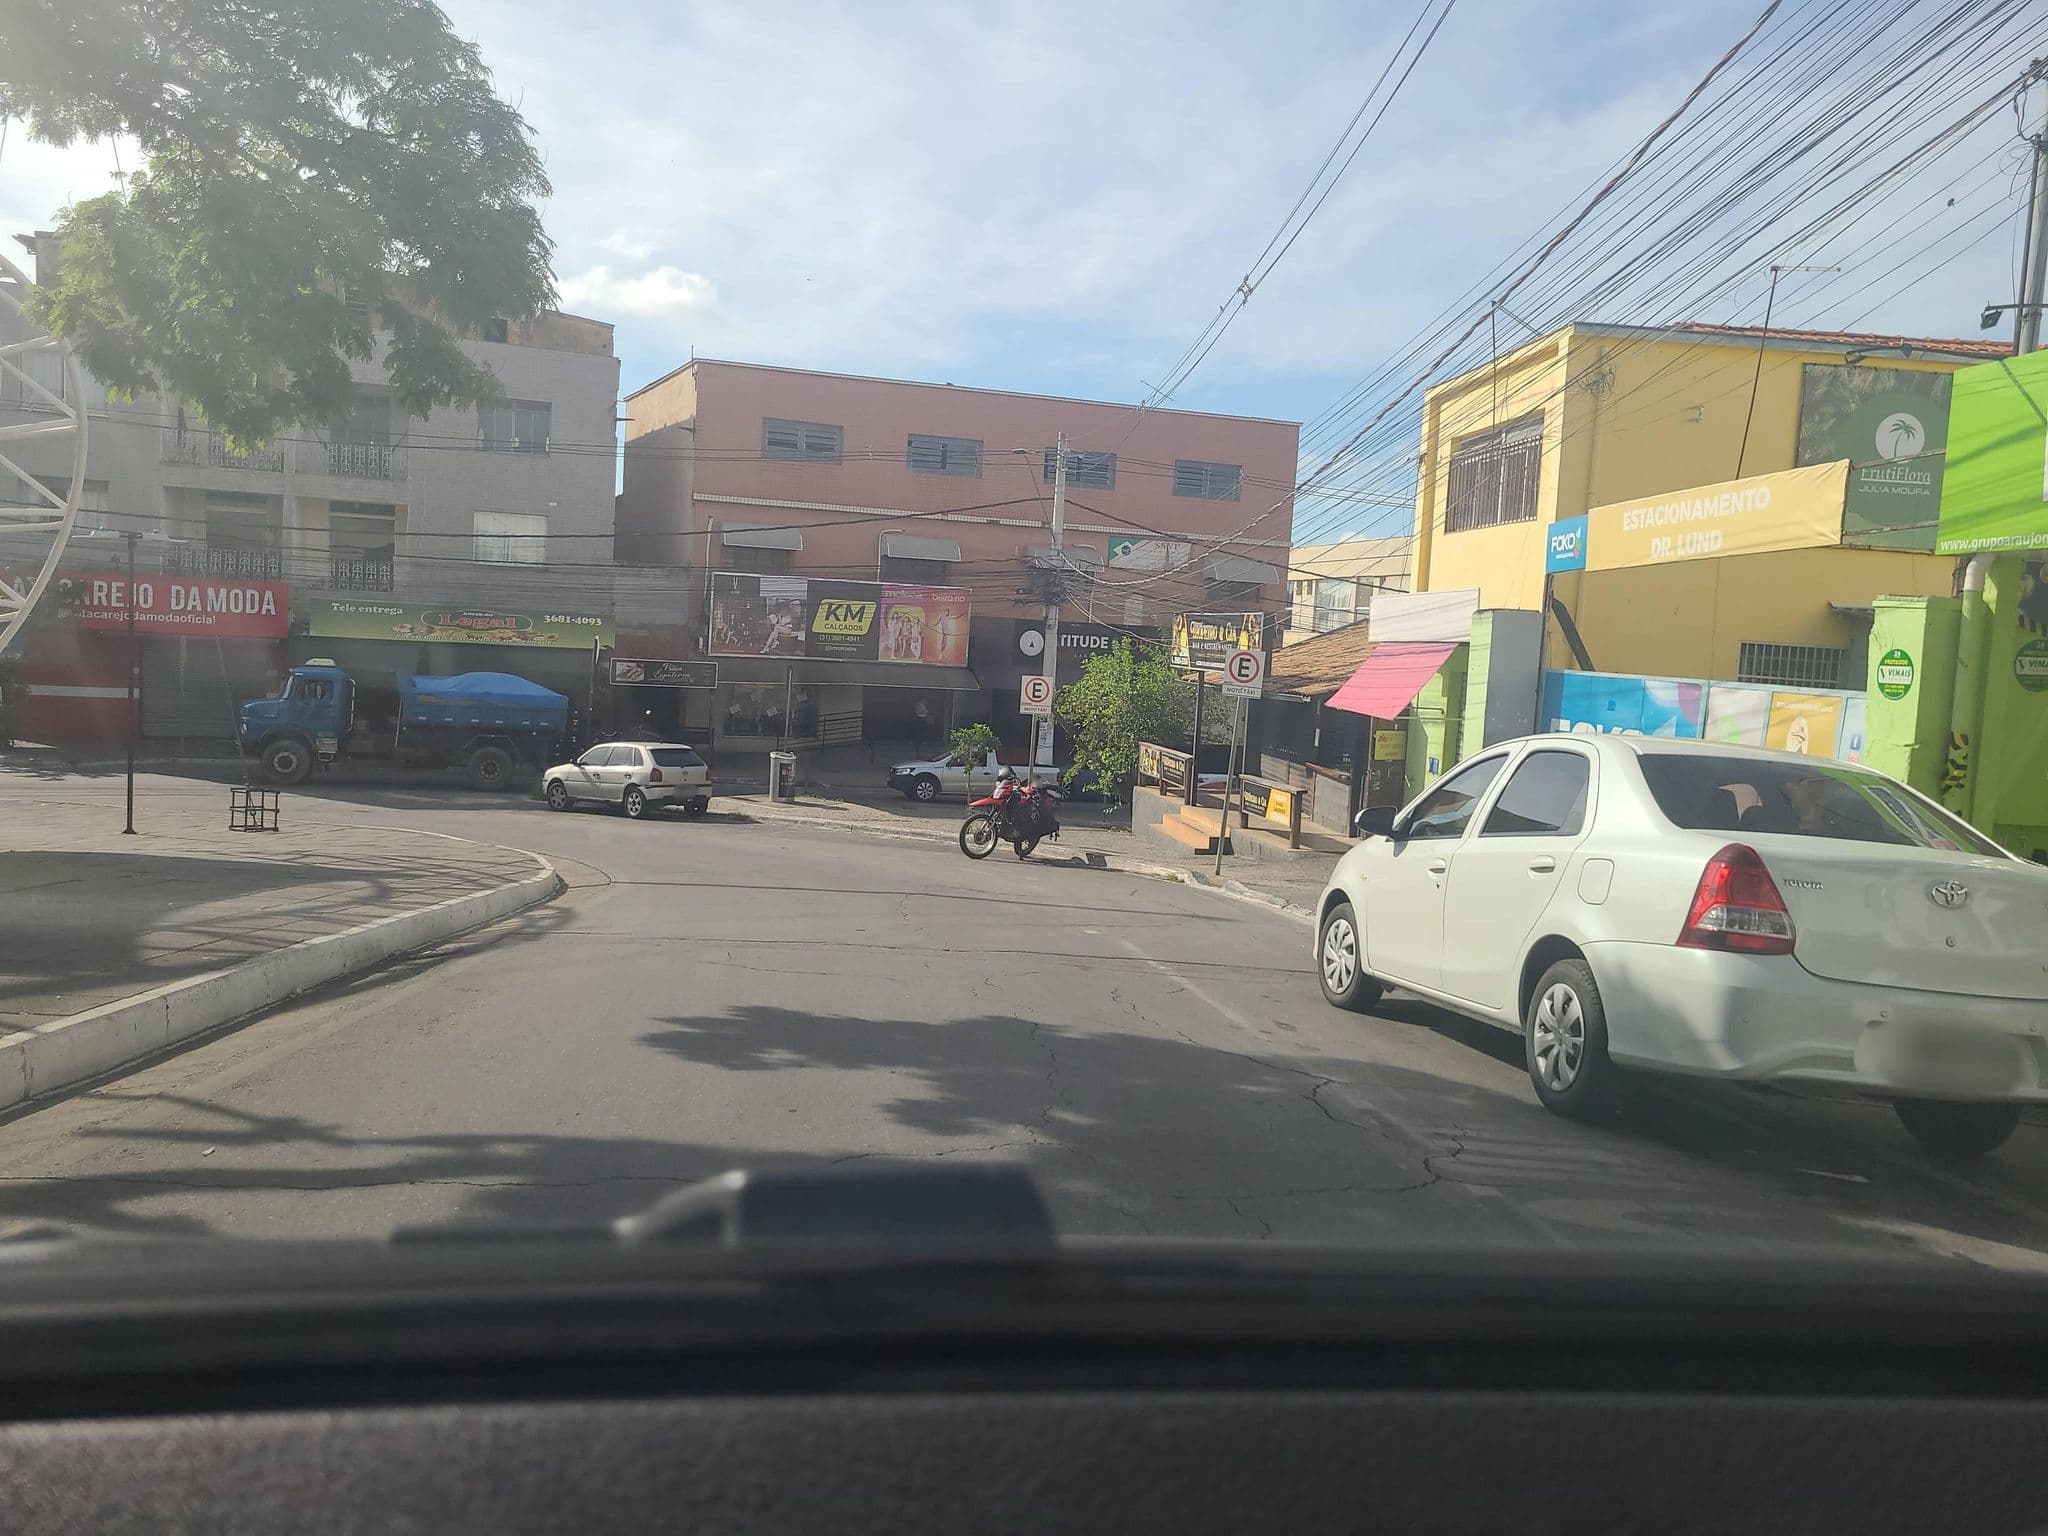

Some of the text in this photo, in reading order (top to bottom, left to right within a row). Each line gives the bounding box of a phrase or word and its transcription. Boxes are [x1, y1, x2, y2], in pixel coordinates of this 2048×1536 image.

[1861, 466, 1931, 482] FrutiFlora
[1891, 486, 1930, 496] MOURA
[1622, 487, 1771, 530] ESTACIONAMENTO
[1650, 530, 1722, 559] DR. LUND
[331, 602, 403, 616] Tele entrega
[824, 602, 866, 622] KM
[438, 613, 517, 629] Legal
[824, 623, 863, 632] CALÇADOS
[1060, 634, 1109, 649] TITUDE
[1237, 657, 1252, 678] E
[1888, 669, 1911, 677] VIMAIS
[1032, 682, 1042, 698] E
[1783, 879, 1824, 890] TOYOTA
